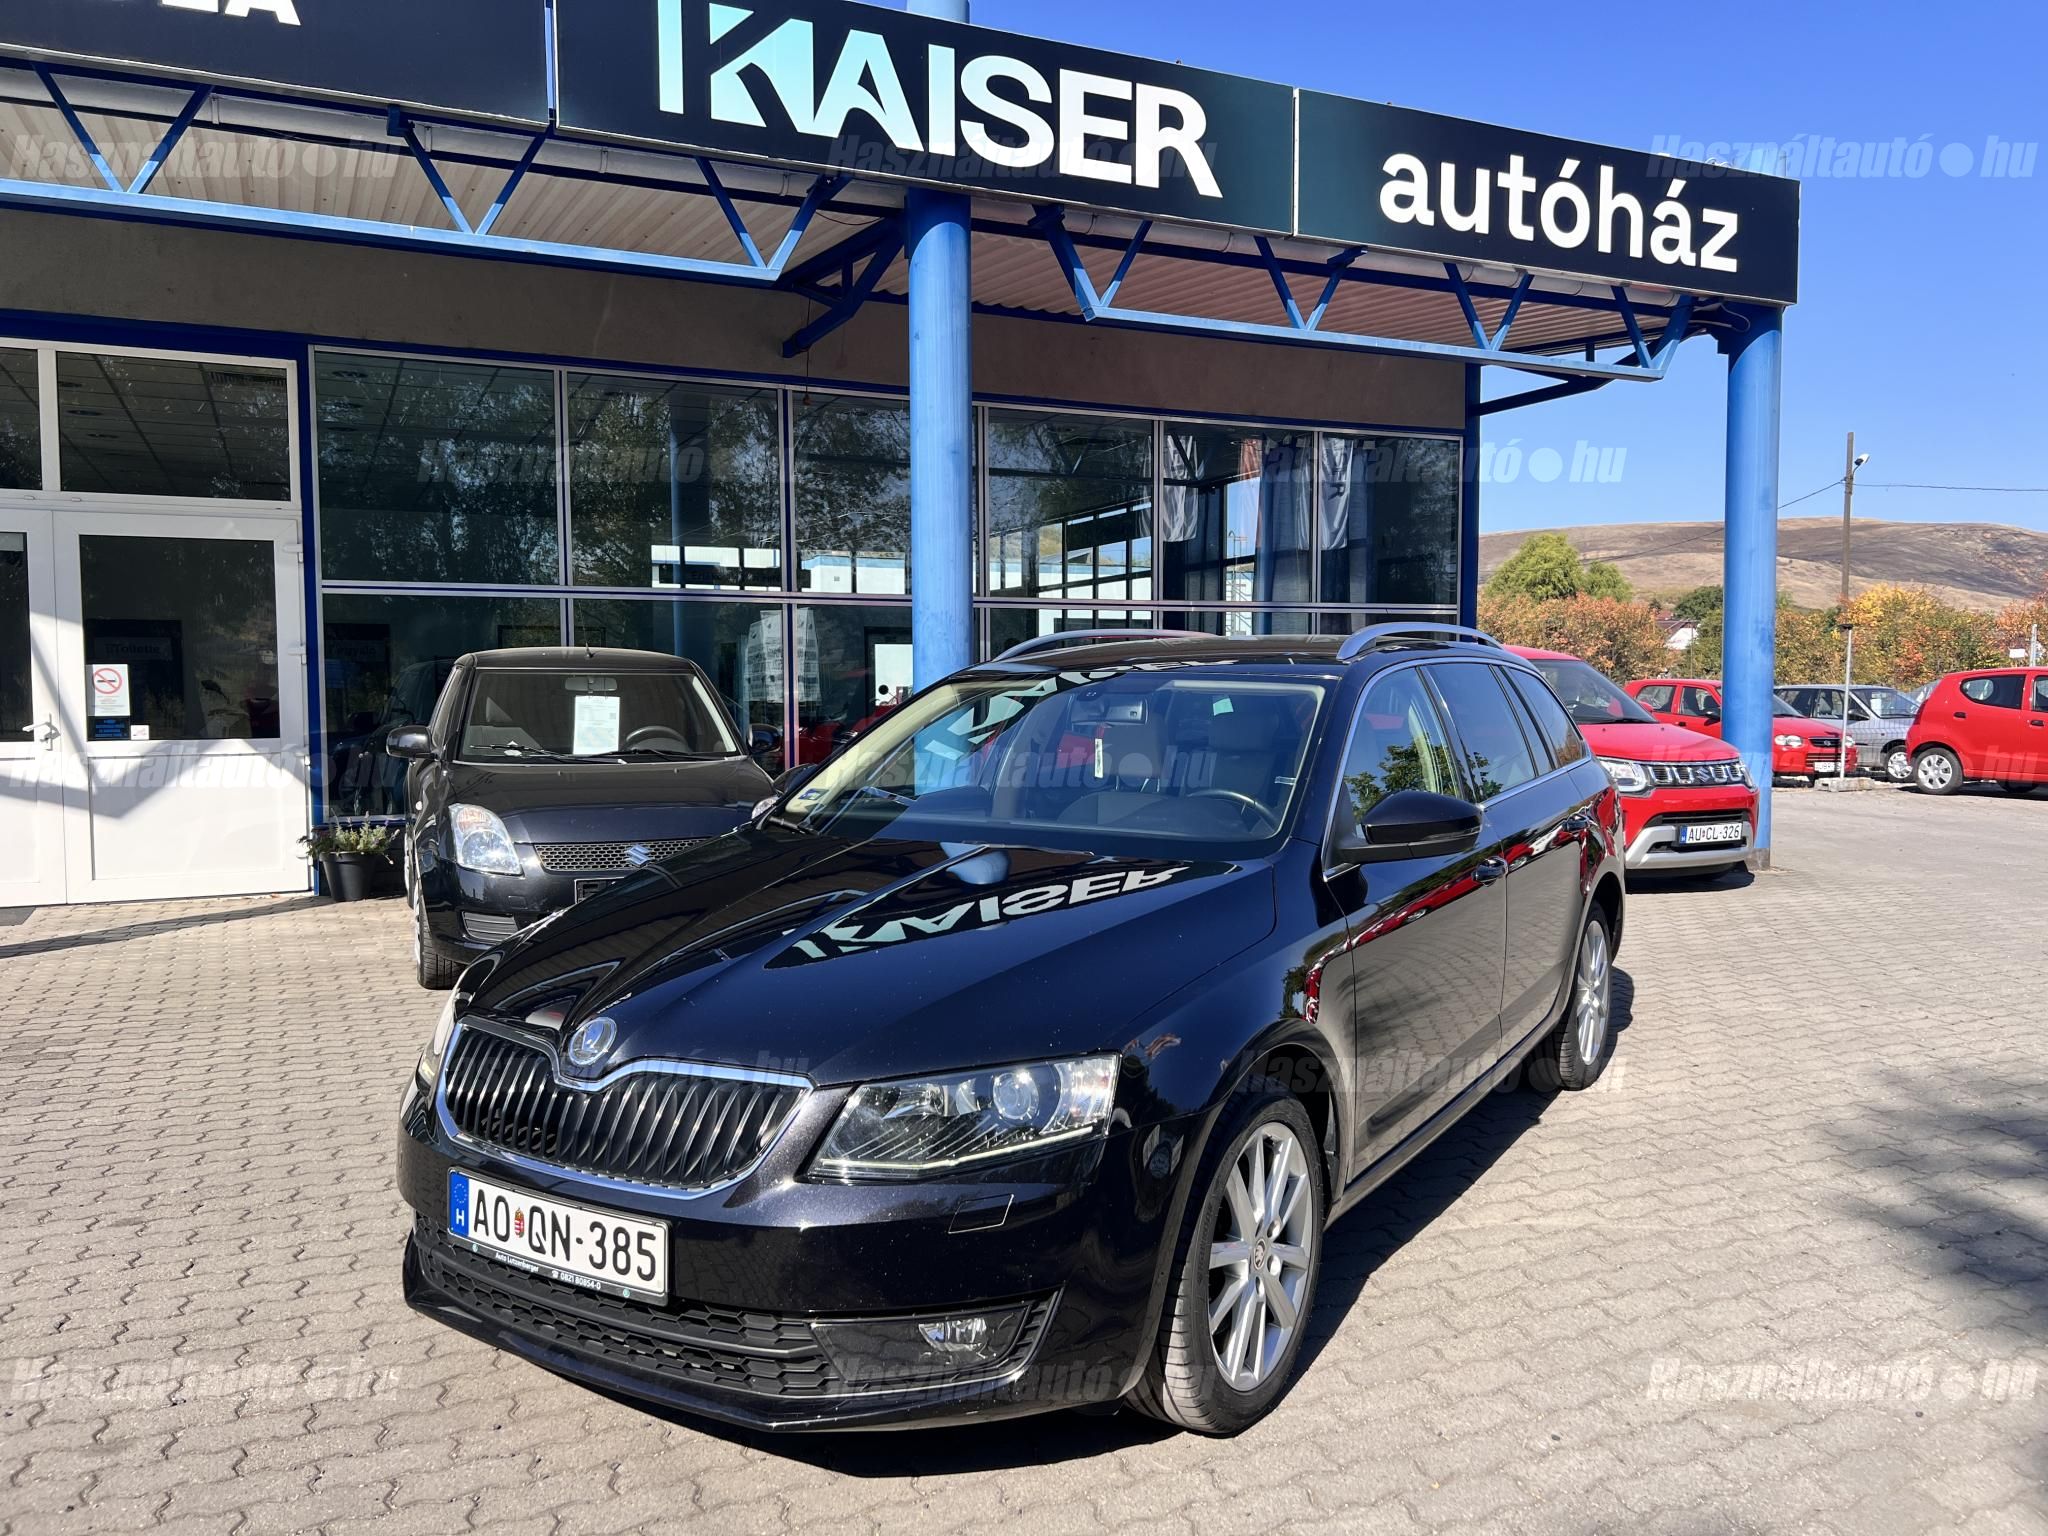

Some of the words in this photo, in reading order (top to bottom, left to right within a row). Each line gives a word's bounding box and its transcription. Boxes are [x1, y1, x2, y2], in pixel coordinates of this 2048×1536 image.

[658, 0, 1223, 199] KAISER
[1380, 153, 1738, 273] autóház
[455, 1208, 465, 1226] H
